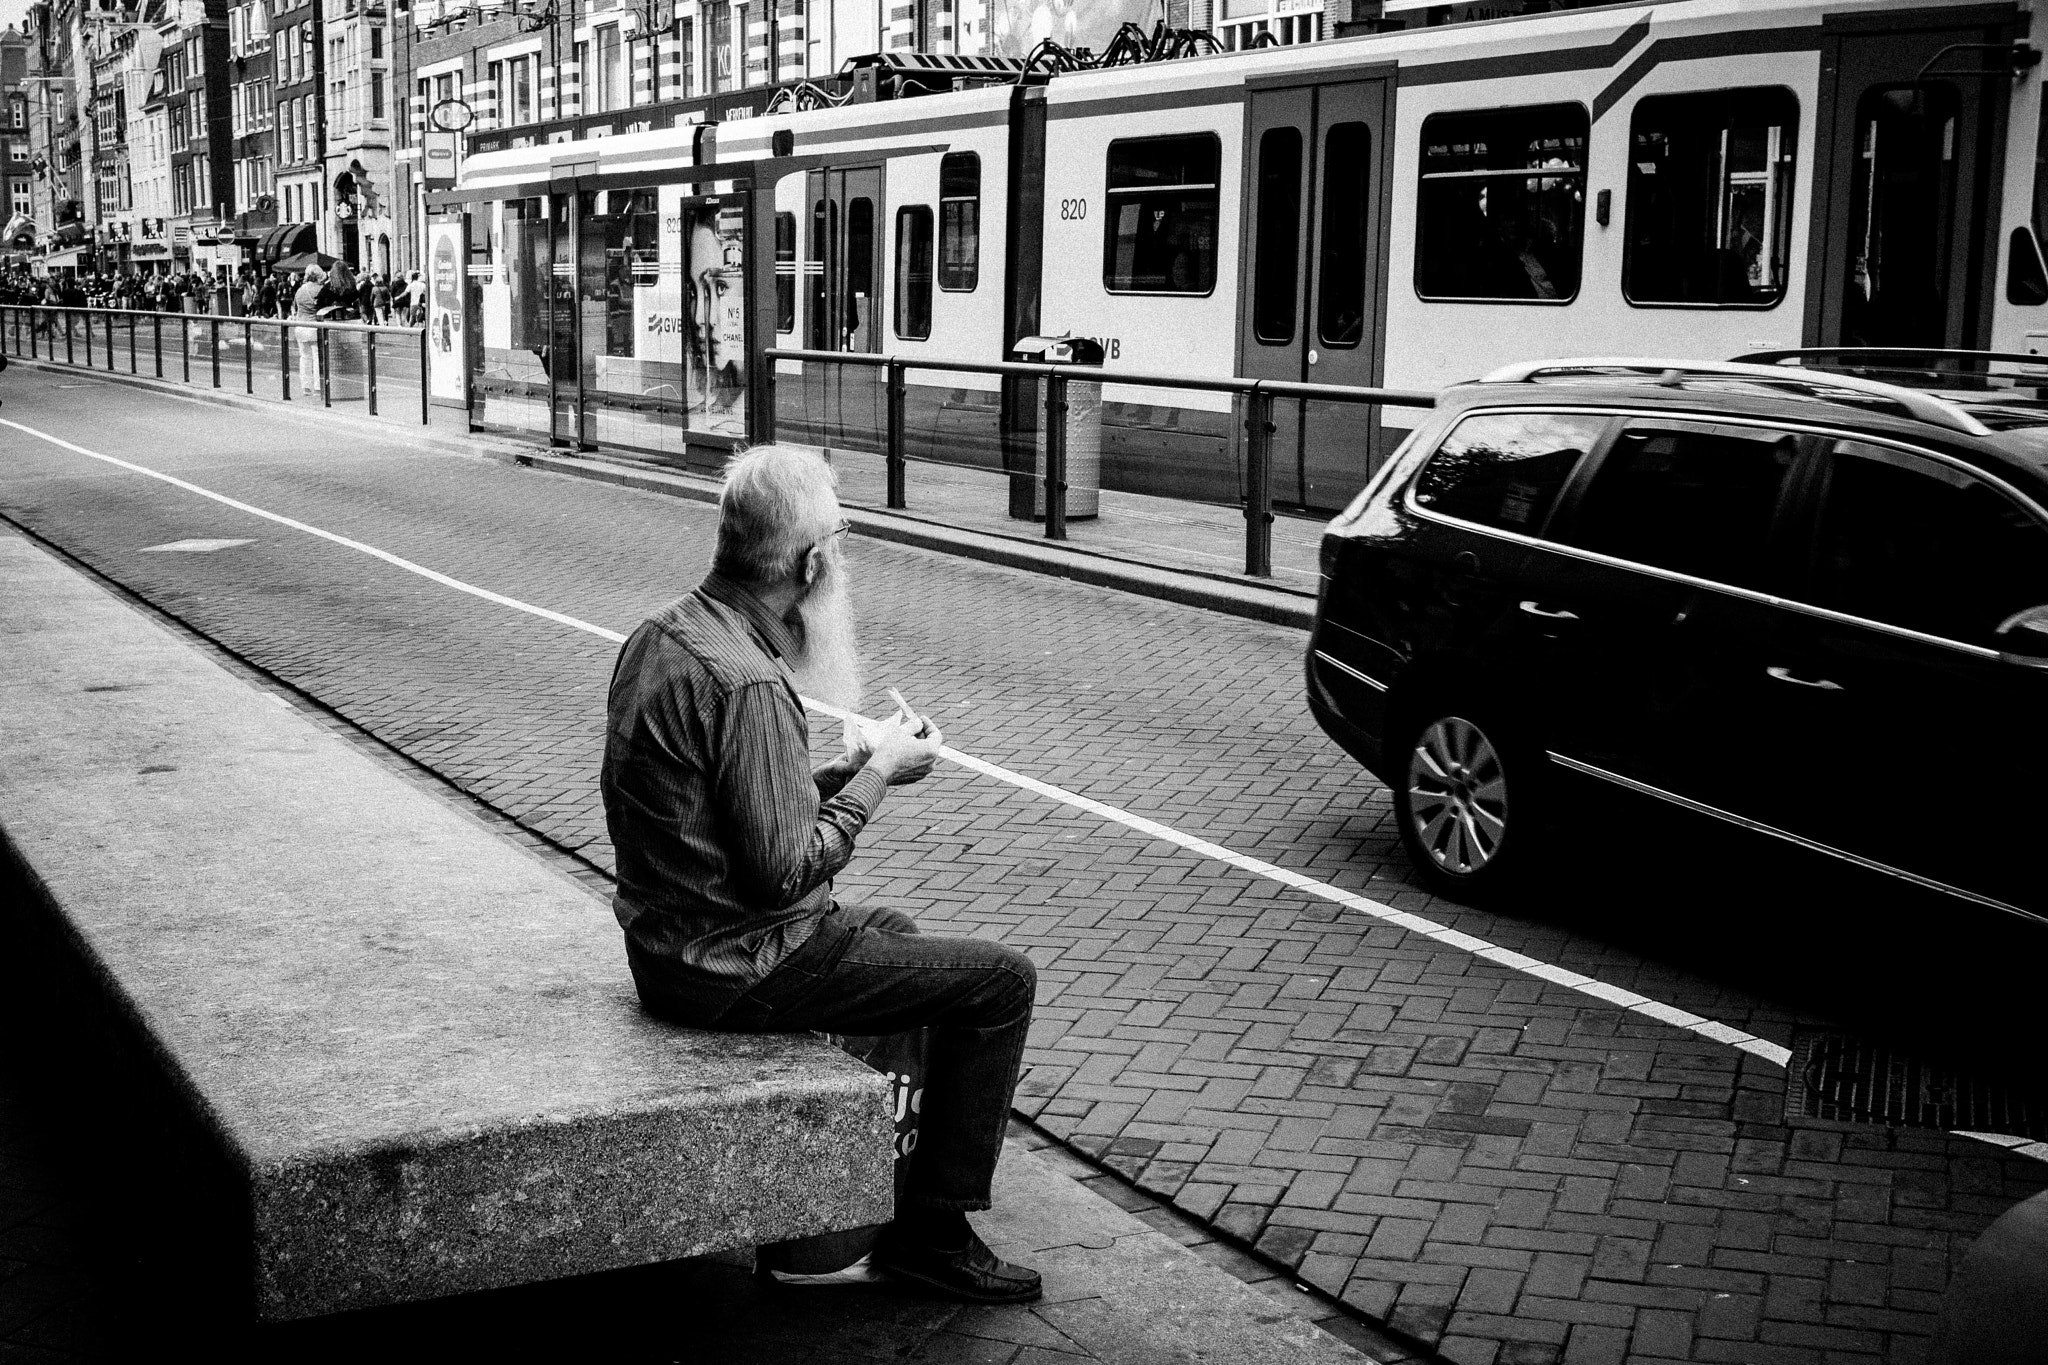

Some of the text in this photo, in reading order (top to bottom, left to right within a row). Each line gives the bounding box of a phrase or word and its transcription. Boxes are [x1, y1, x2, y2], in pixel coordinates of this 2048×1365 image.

[480, 141, 500, 152] PRIMARK
[1061, 198, 1086, 220] 820
[664, 317, 682, 333] GVB
[723, 333, 743, 342] CHANEL
